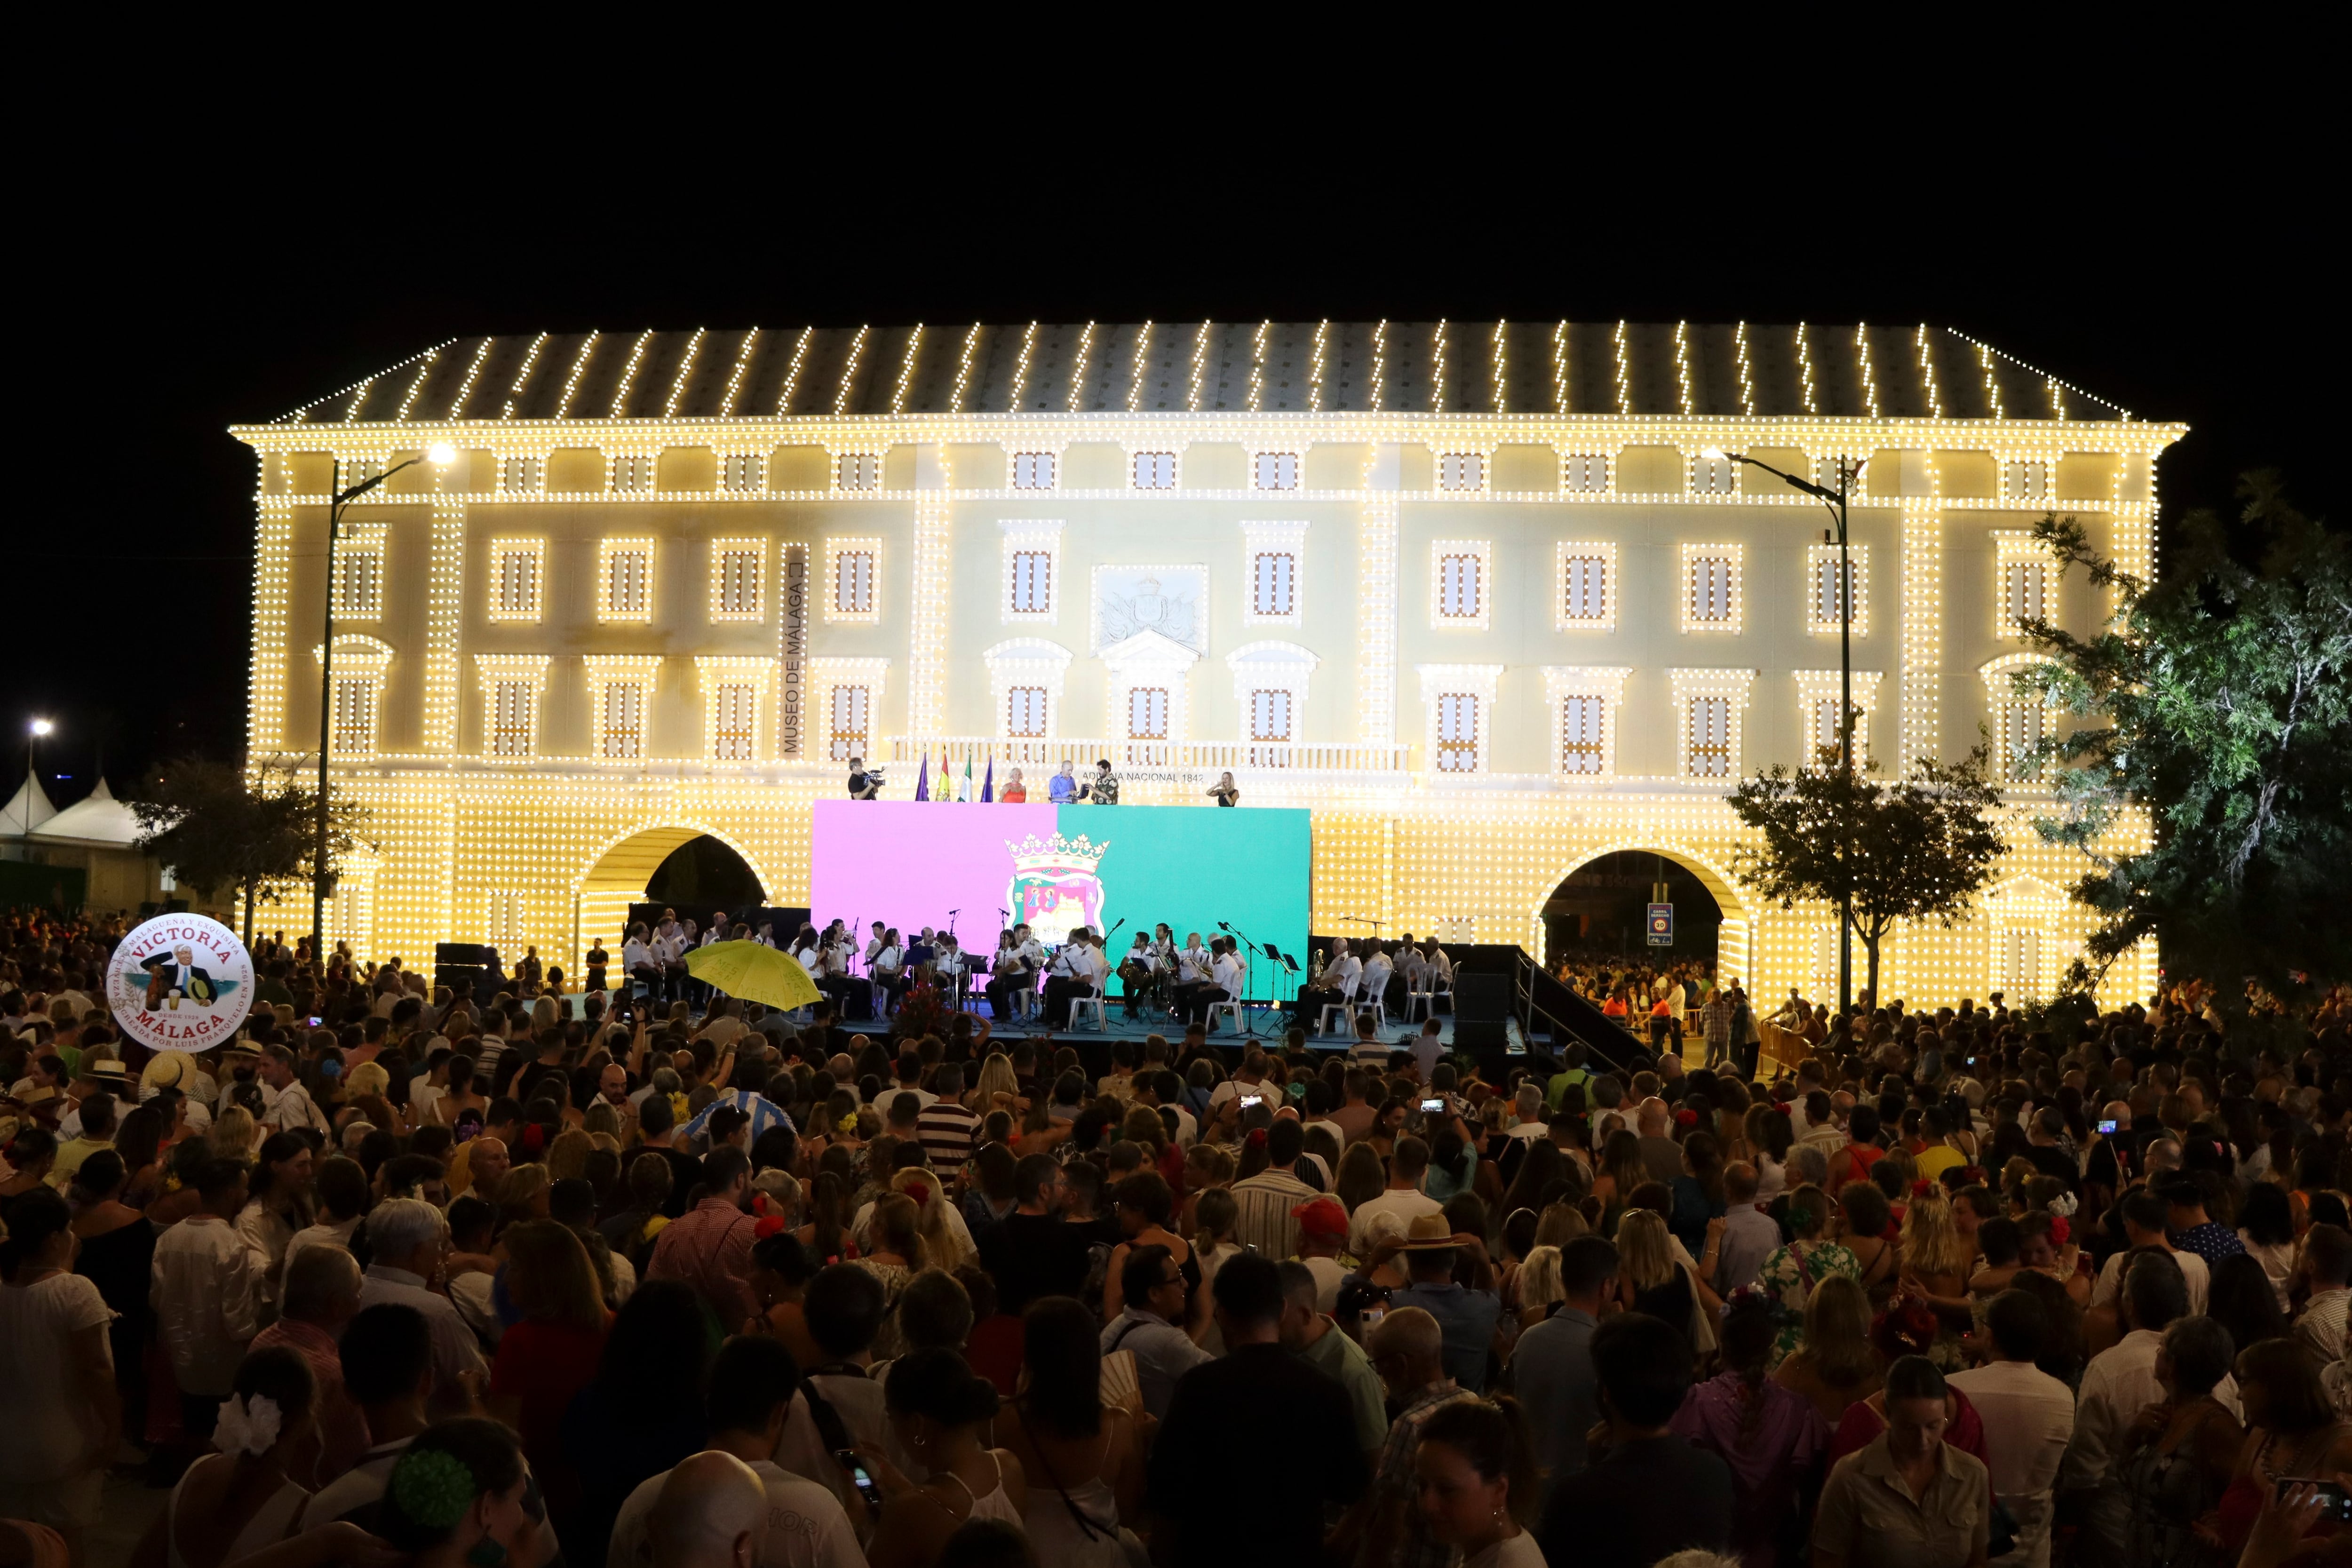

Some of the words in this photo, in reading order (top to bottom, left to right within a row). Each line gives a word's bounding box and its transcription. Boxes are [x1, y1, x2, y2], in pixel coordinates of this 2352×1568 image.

[785, 583, 802, 654] MÁLAGA
[787, 661, 799, 683] DE
[785, 690, 799, 753] MUSEO
[1127, 772, 1177, 782] NACIONAL
[1182, 774, 1203, 783] 1842
[129, 918, 185, 947] MALAGUEÑA
[197, 921, 239, 955] EXQUISITA
[132, 927, 230, 964] VICTORIA
[741, 984, 780, 1005] VEGA
[121, 1009, 150, 1039] CREADA
[152, 1036, 171, 1046] POR
[201, 1001, 244, 1043] FRANQUELO
[241, 987, 248, 998] EN
[135, 1009, 224, 1038] MÁLAGA
